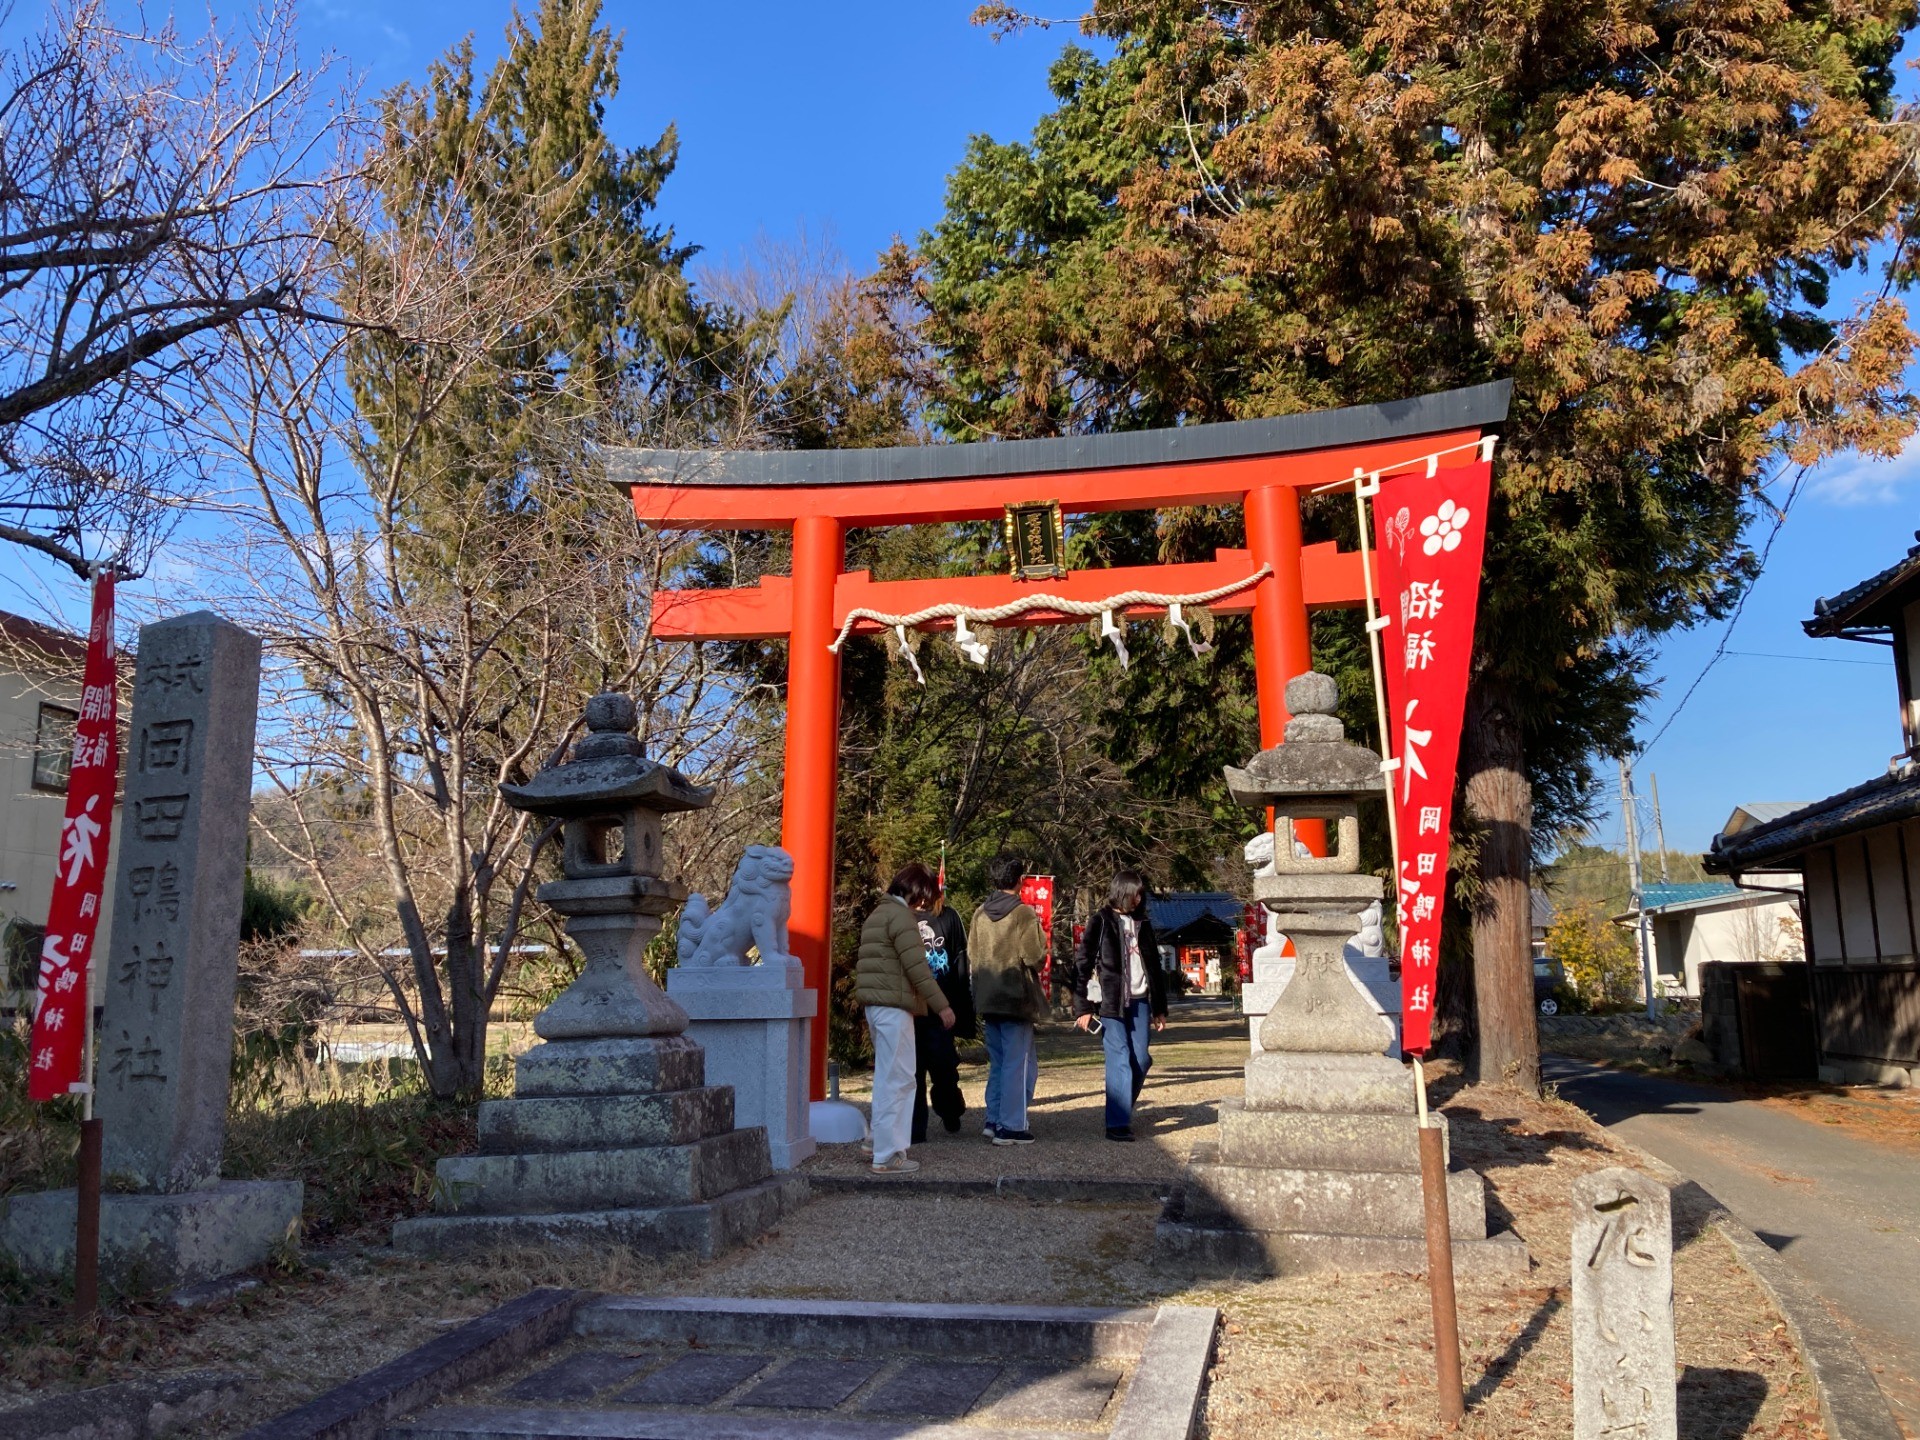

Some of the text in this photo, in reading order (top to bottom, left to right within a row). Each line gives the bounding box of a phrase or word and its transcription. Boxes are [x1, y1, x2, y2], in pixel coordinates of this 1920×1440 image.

[108, 718, 194, 1091] 岡田鴨神社
